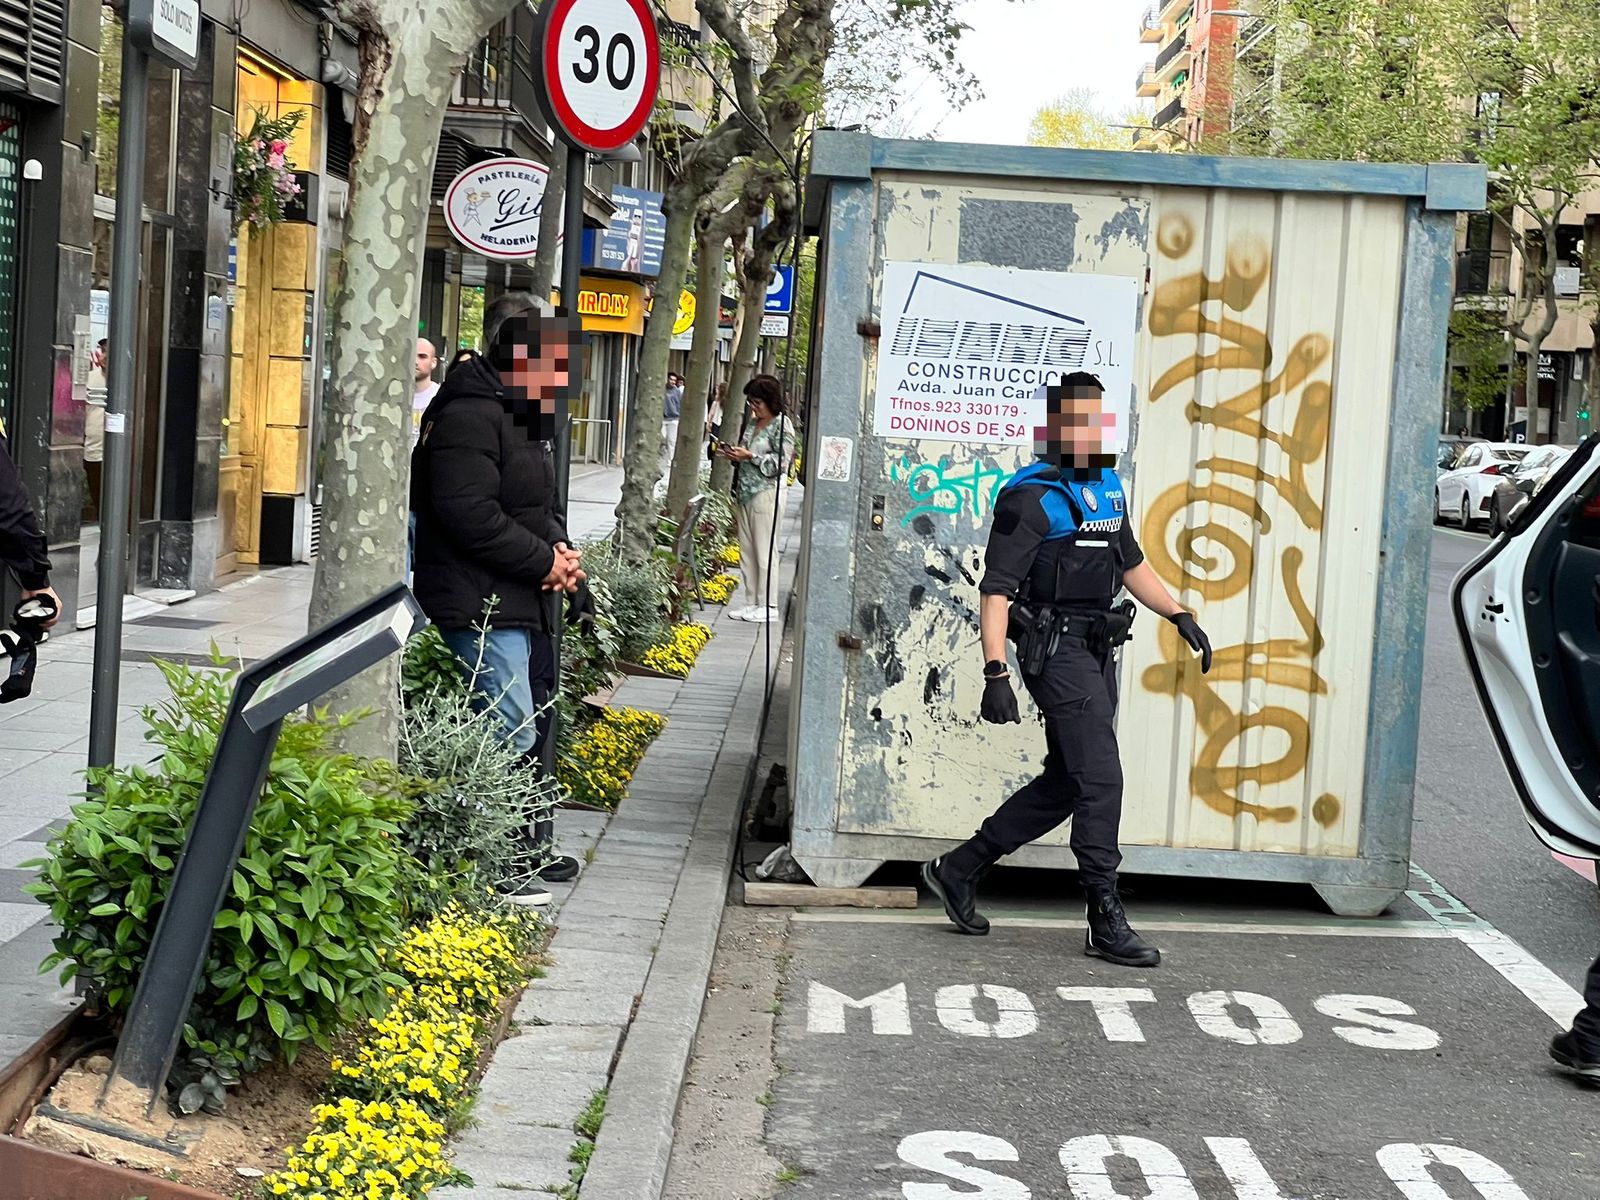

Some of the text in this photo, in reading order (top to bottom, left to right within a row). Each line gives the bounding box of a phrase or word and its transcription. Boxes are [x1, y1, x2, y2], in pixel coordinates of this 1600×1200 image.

[572, 25, 636, 91] 30
[478, 170, 541, 186] PASTELERÍA
[480, 232, 538, 246] HELADERÍA
[1092, 340, 1120, 367] S.L.
[907, 361, 1100, 385] CONSTRUCCIO
[897, 379, 1037, 400] Avda. Juan Car
[966, 402, 1019, 418] 330179
[890, 414, 1026, 438] DOÑINOS DE SA
[1515, 433, 1526, 444] P
[806, 979, 1443, 1051] MOTOS
